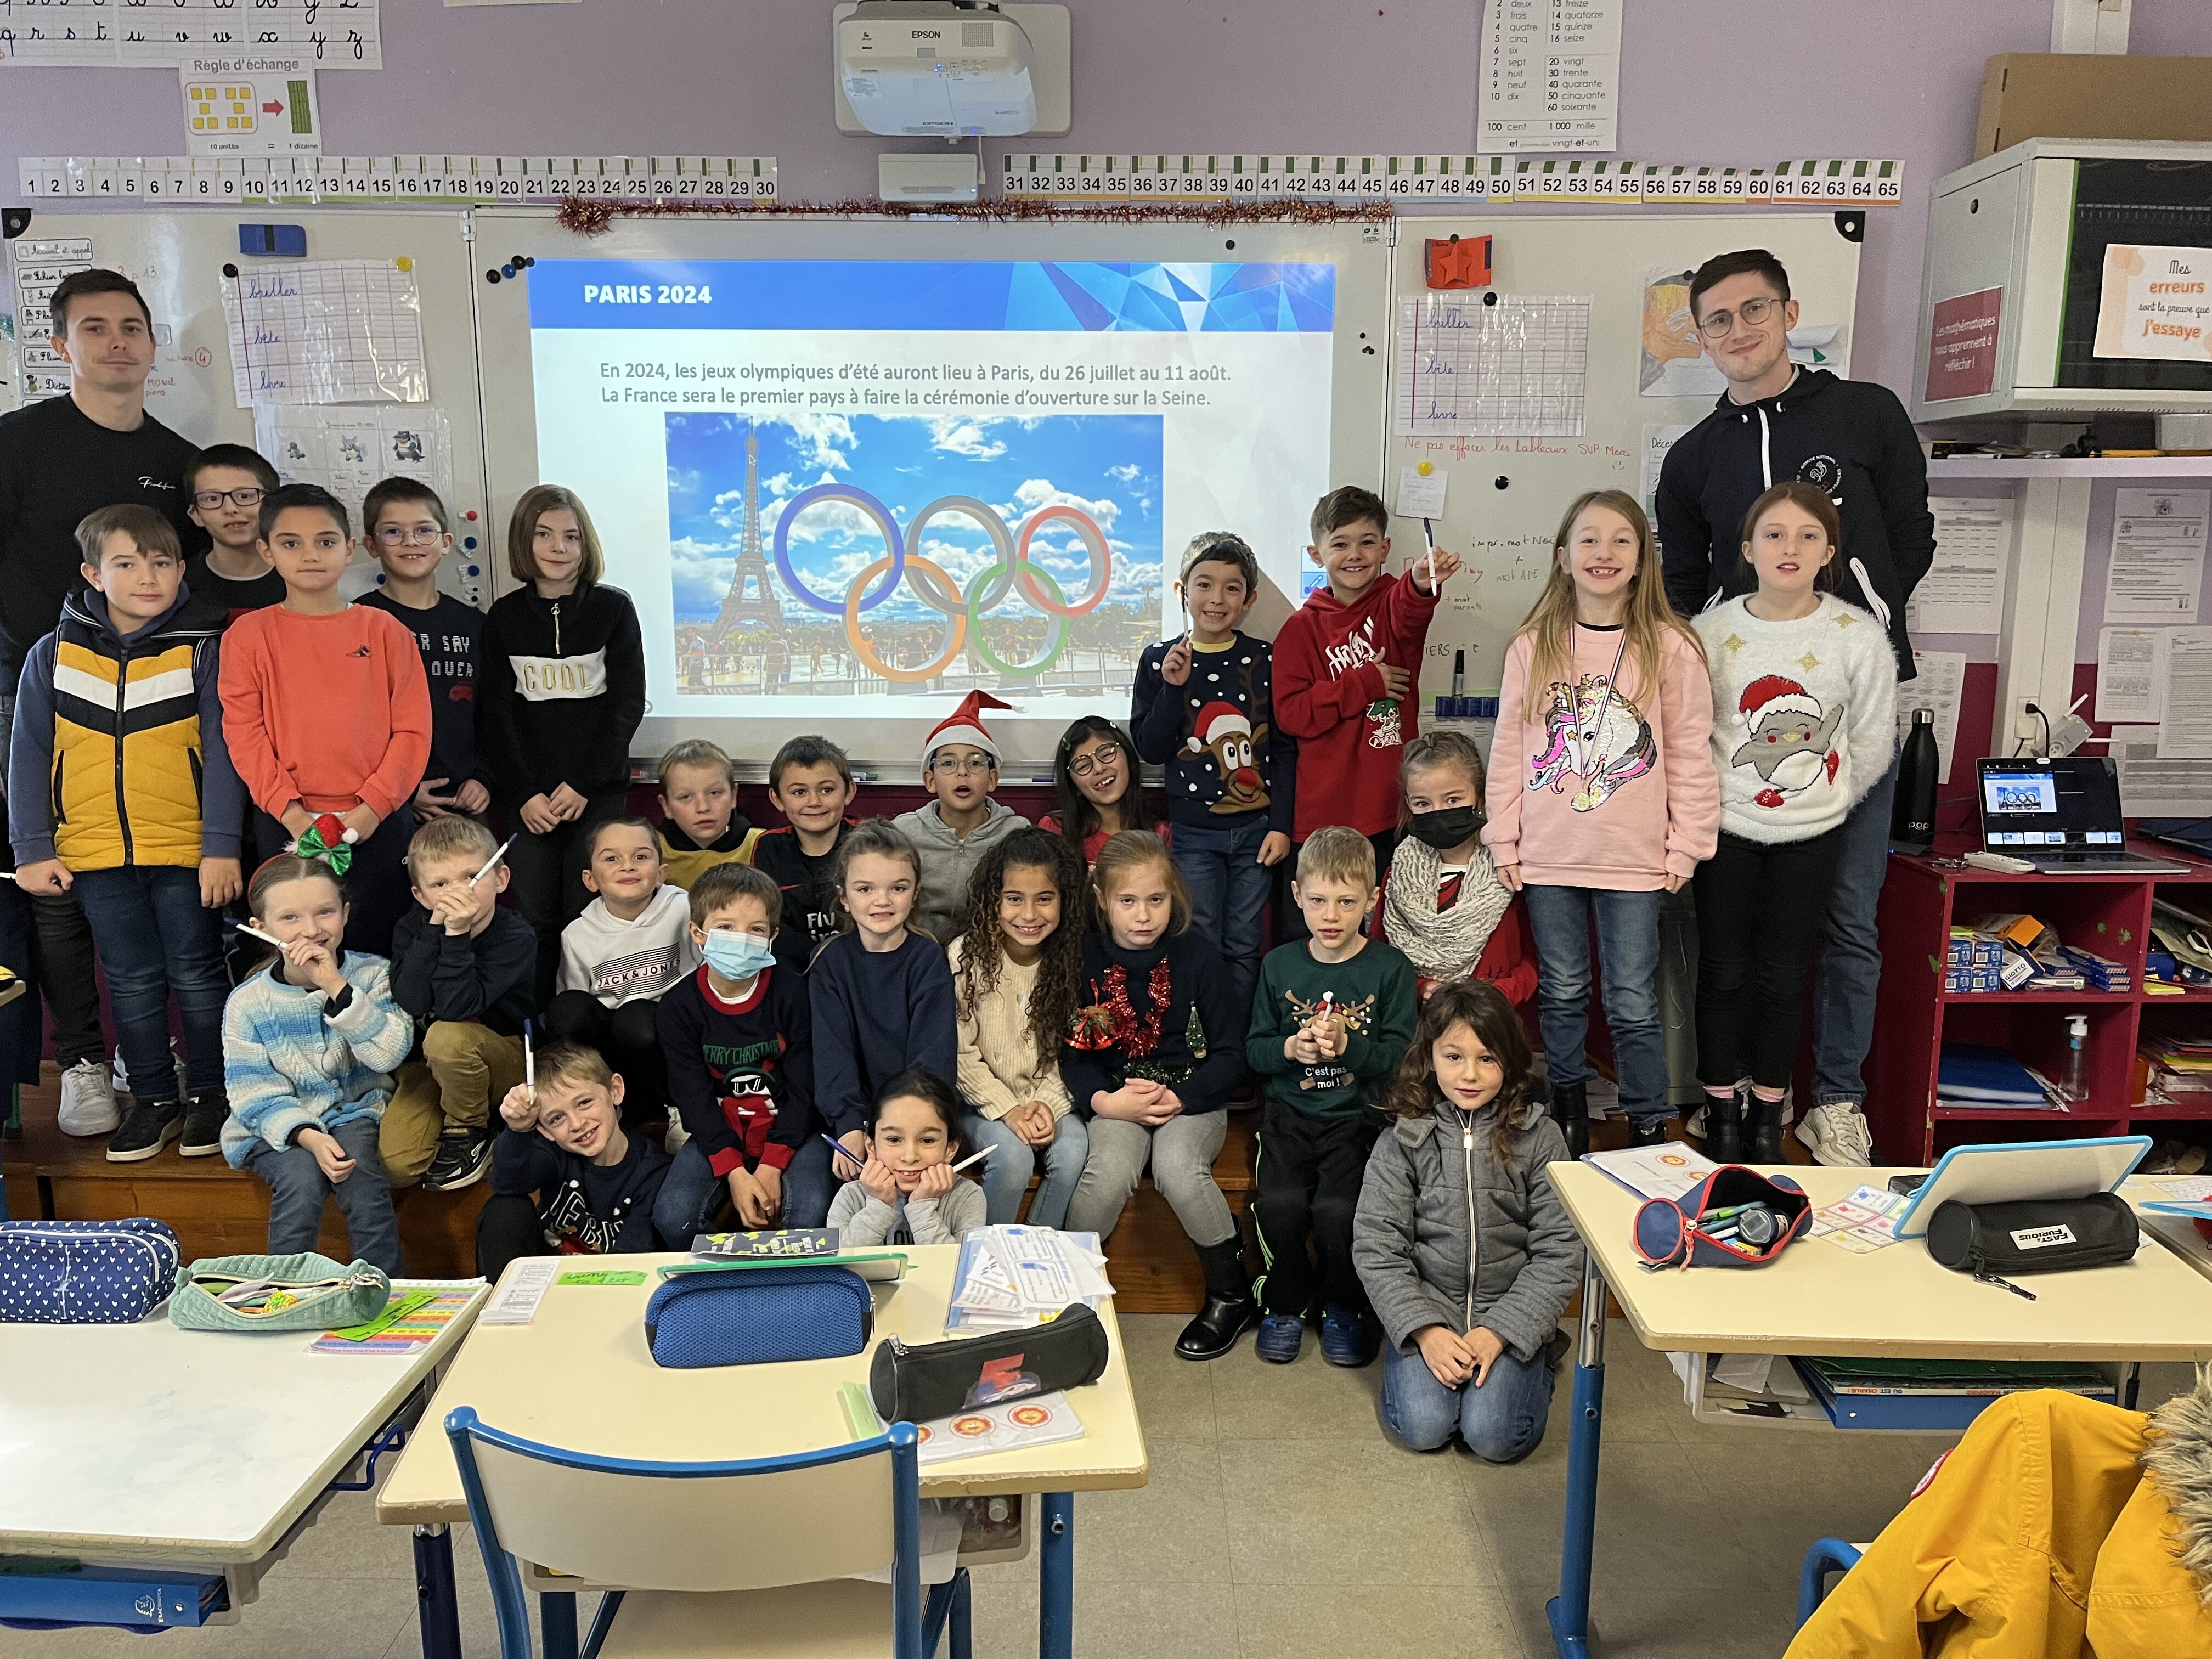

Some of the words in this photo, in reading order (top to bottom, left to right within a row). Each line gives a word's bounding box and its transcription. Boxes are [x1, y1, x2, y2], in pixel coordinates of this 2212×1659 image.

[1565, 12, 1603, 20] quatorze
[1564, 24, 1593, 32] quinze
[194, 60, 230, 73] Règle
[233, 59, 299, 72] d'échange
[1562, 58, 1584, 67] vingt
[1562, 81, 1602, 89] quarante
[1561, 92, 1606, 101] cinquante
[28, 179, 35, 193] 1
[51, 179, 60, 193] 2
[76, 179, 85, 193] 3
[100, 179, 110, 192] 4
[126, 179, 135, 192] 5
[150, 180, 159, 194] 6
[174, 180, 183, 193] 7
[199, 180, 208, 193] 8
[224, 180, 233, 194] 9
[245, 180, 264, 194] 10
[272, 179, 287, 193] 11
[296, 179, 313, 193] 12
[320, 178, 339, 192] 13
[346, 179, 365, 192] 14
[373, 179, 391, 193] 15
[398, 179, 417, 193] 16
[423, 179, 441, 193] 17
[448, 179, 467, 193] 18
[475, 180, 493, 194] 19
[500, 180, 519, 194] 20
[526, 180, 543, 193] 21
[551, 179, 570, 193] 22
[577, 180, 596, 194] 23
[602, 180, 621, 194] 24
[628, 180, 647, 194] 25
[654, 180, 673, 194] 26
[679, 180, 698, 194] 27
[704, 180, 724, 194] 28
[730, 181, 749, 195] 29
[755, 182, 775, 195] 30
[1006, 177, 1023, 191] 31
[1031, 177, 1050, 190] 32
[1057, 177, 1075, 190] 33
[1082, 177, 1101, 191] 34
[1108, 178, 1126, 191] 35
[1133, 178, 1152, 191] 36
[1159, 178, 1178, 191] 37
[1184, 178, 1203, 192] 38
[1210, 178, 1228, 192] 39
[1234, 178, 1254, 192] 40
[1261, 178, 1278, 191] 41
[1286, 178, 1306, 191] 42
[1312, 178, 1330, 192] 43
[1337, 179, 1356, 193] 44
[1362, 179, 1381, 193] 45
[1389, 180, 1408, 193] 46
[1415, 179, 1435, 193] 47
[1441, 179, 1459, 193] 48
[1465, 180, 1485, 193] 49
[1492, 180, 1510, 193] 50
[1517, 178, 1534, 191] 51
[1543, 178, 1562, 192] 52
[1568, 179, 1587, 192] 53
[1594, 179, 1613, 193] 54
[1620, 179, 1639, 193] 55
[1646, 180, 1665, 193] 56
[1672, 180, 1691, 194] 57
[1697, 180, 1716, 194] 58
[1723, 180, 1742, 194] 59
[1749, 180, 1768, 194] 60
[1776, 180, 1793, 194] 61
[1802, 181, 1820, 194] 62
[1827, 182, 1846, 195] 63
[1853, 182, 1871, 196] 64
[1878, 183, 1898, 196] 65
[2169, 259, 2191, 274] Mes
[584, 285, 652, 303] PARIS
[658, 285, 712, 304] 2024
[2149, 281, 2205, 294] erreurs
[2138, 302, 2156, 312] sont
[2158, 301, 2166, 312] la
[2167, 306, 2194, 317] preuve
[2195, 307, 2210, 318] que
[2142, 318, 2202, 342] j'essaye
[601, 363, 619, 377] En
[625, 363, 669, 380] 2024,
[676, 363, 697, 378] les
[701, 363, 736, 381] jeux
[740, 363, 833, 382] olympiques
[839, 363, 878, 379] d'été
[884, 366, 938, 380] auront
[943, 364, 971, 380] lieu
[978, 364, 985, 380] à
[992, 365, 1034, 383] Paris,
[1040, 365, 1059, 380] du
[1065, 366, 1085, 380] 26
[1089, 365, 1135, 383] juillet
[1140, 369, 1159, 380] au
[1165, 366, 1184, 380] 11
[1189, 365, 1231, 380] août.
[602, 387, 618, 402] La
[625, 388, 677, 402] France
[683, 392, 715, 402] sera
[721, 387, 735, 403] le
[740, 388, 804, 407] premier
[810, 393, 844, 407] pays
[850, 388, 858, 404] à
[864, 388, 900, 404] faire
[905, 388, 918, 404] la
[924, 389, 1009, 405] cérémonie
[1015, 390, 1108, 405] d'ouverture
[1114, 394, 1139, 405] sur
[1144, 390, 1156, 405] la
[1162, 391, 1211, 405] Seine.
[1405, 436, 1420, 448] Ne
[1426, 442, 1443, 458] pas
[1492, 437, 1509, 452] les
[1515, 437, 1570, 454] tableaux
[1578, 444, 1599, 454] SVP
[442, 635, 470, 653] SAY
[523, 664, 596, 692] COOL
[806, 912, 835, 929] Fly
[2005, 963, 2026, 981] GIOTTO
[730, 1040, 780, 1065] CHRISTMA
[1305, 1066, 1329, 1076] C'est
[1330, 1067, 1347, 1077] pas
[1317, 1079, 1334, 1088] moi
[2019, 1229, 2063, 1240] FURIOUS
[2041, 1233, 2068, 1243] FAST
